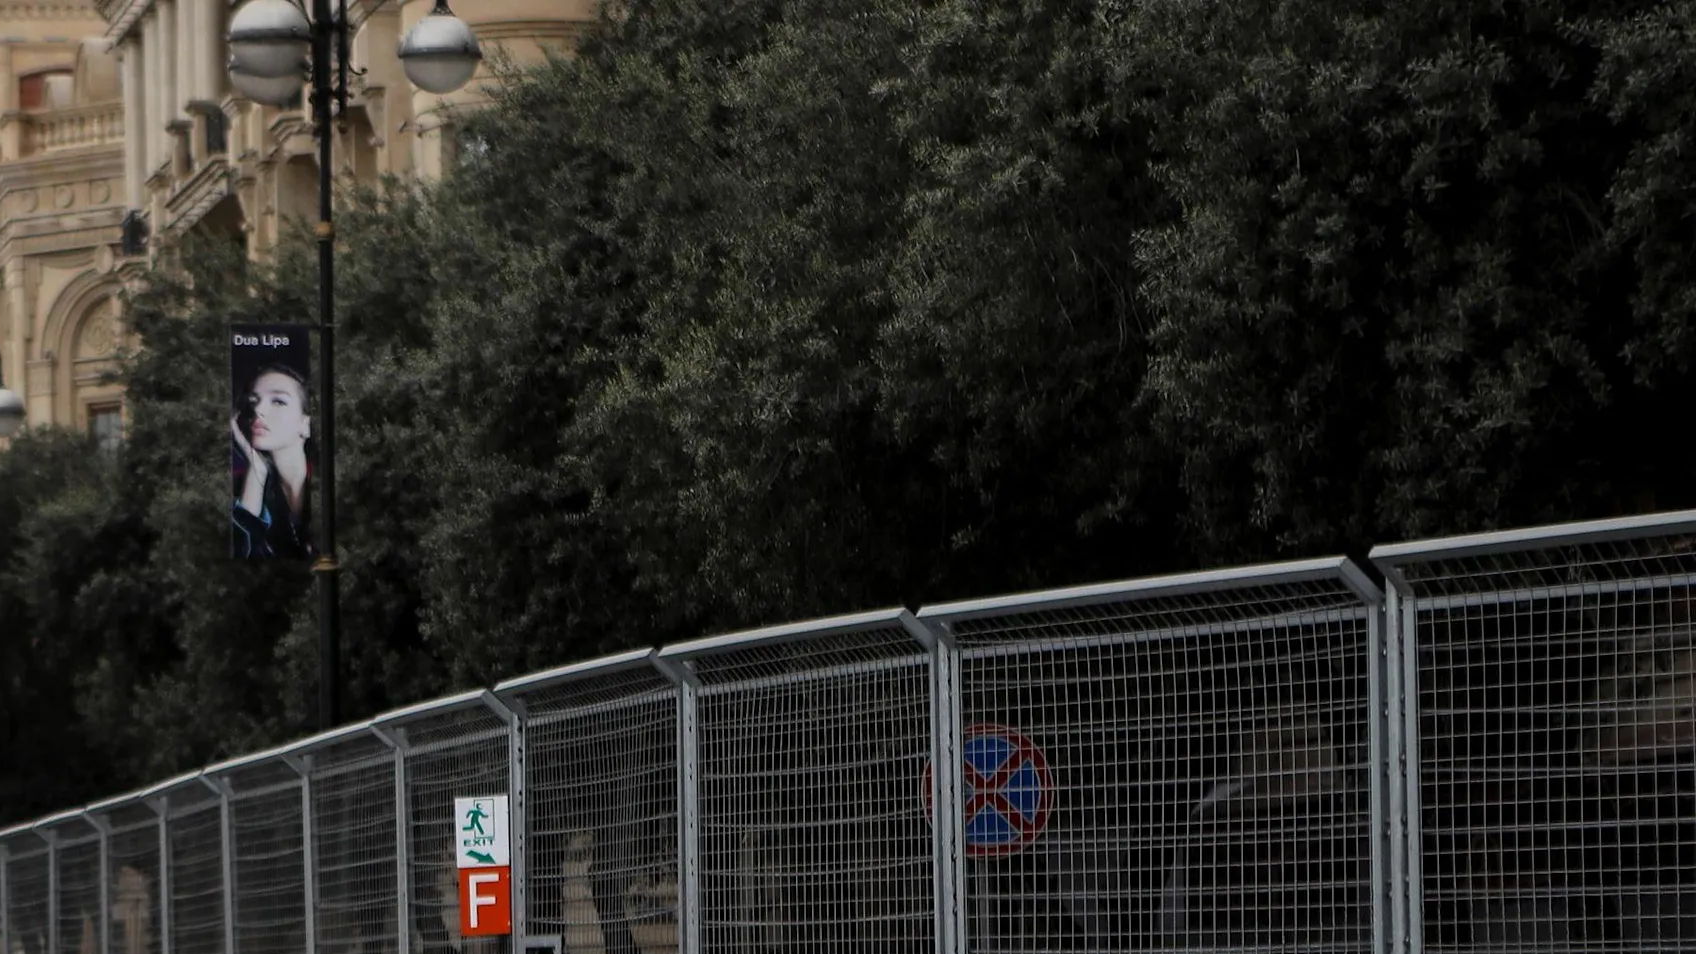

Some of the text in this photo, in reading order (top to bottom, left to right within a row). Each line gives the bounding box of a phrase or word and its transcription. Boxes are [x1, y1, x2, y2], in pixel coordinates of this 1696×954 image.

[234, 334, 291, 349] Dua Lipa
[463, 838, 495, 847] EXIT
[468, 873, 500, 929] F
